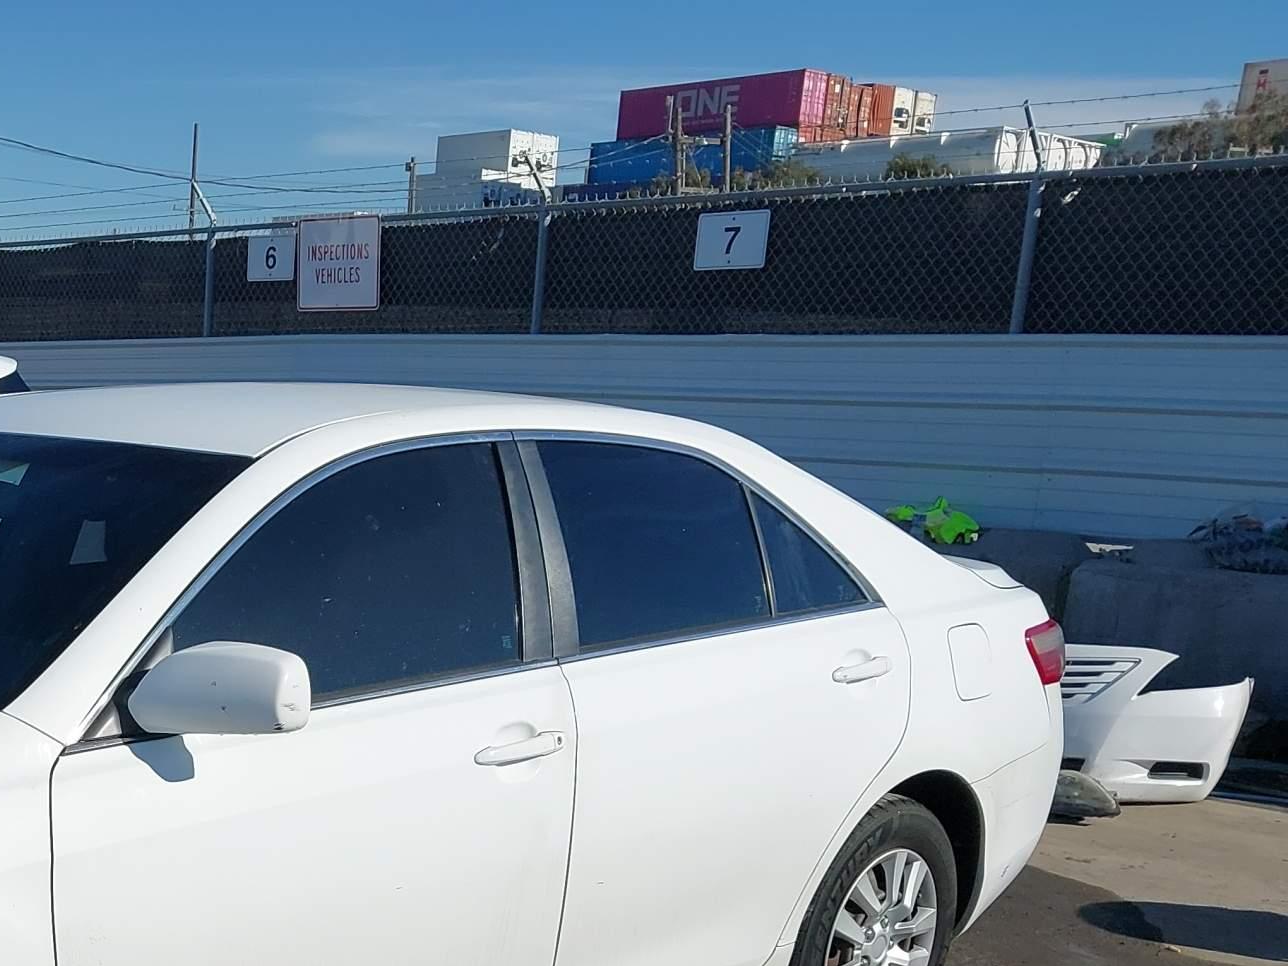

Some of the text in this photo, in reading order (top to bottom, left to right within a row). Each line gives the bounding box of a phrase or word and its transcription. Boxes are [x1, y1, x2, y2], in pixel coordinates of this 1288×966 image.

[674, 84, 741, 118] ONE
[724, 226, 741, 254] 7
[265, 246, 277, 269] 6
[307, 243, 370, 261] INSPECTIONS
[315, 267, 361, 283] VEHICLES
